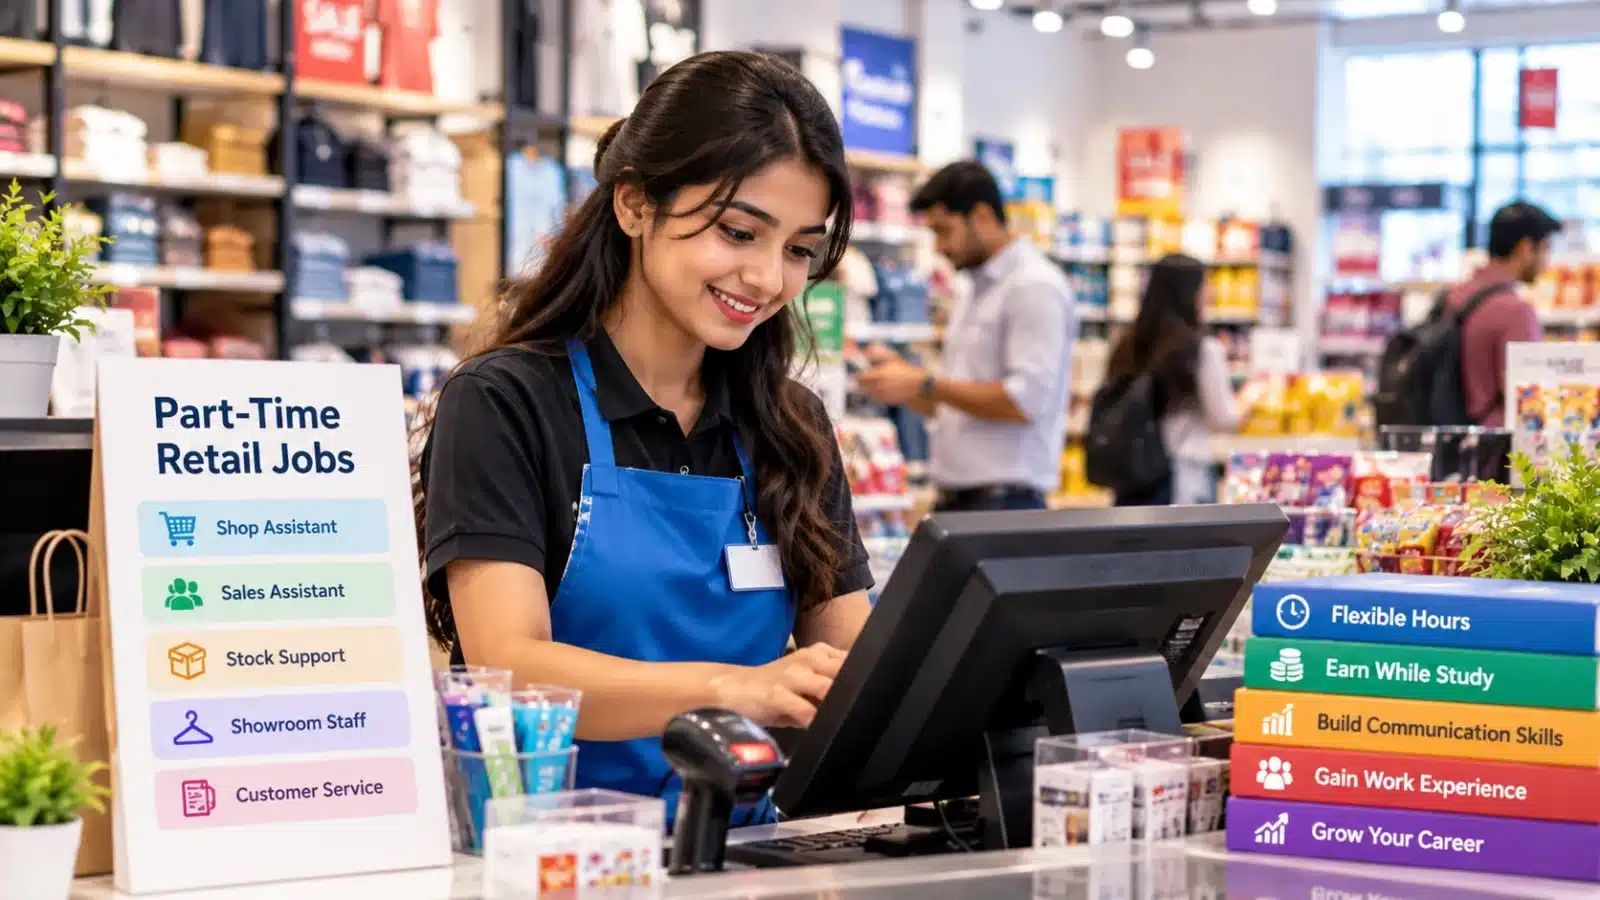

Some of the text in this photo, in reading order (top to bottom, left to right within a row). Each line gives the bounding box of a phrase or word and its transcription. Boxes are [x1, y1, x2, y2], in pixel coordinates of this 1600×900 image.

[154, 396, 341, 430] Part-Time
[157, 440, 355, 475] Retail Jobs
[216, 517, 338, 539] Shop Assistant
[221, 581, 346, 601] Sales Assistant
[1331, 604, 1471, 631] Flexible Hours
[226, 646, 346, 668] Stock Support
[1326, 657, 1495, 692] Earn While Study
[230, 711, 367, 735] Showroom Staff
[1317, 712, 1564, 747] Build Communication Skills
[235, 779, 384, 803] Customer Service
[1314, 766, 1528, 801] Gain Work Experience
[1311, 821, 1485, 853] Grow Your Career
